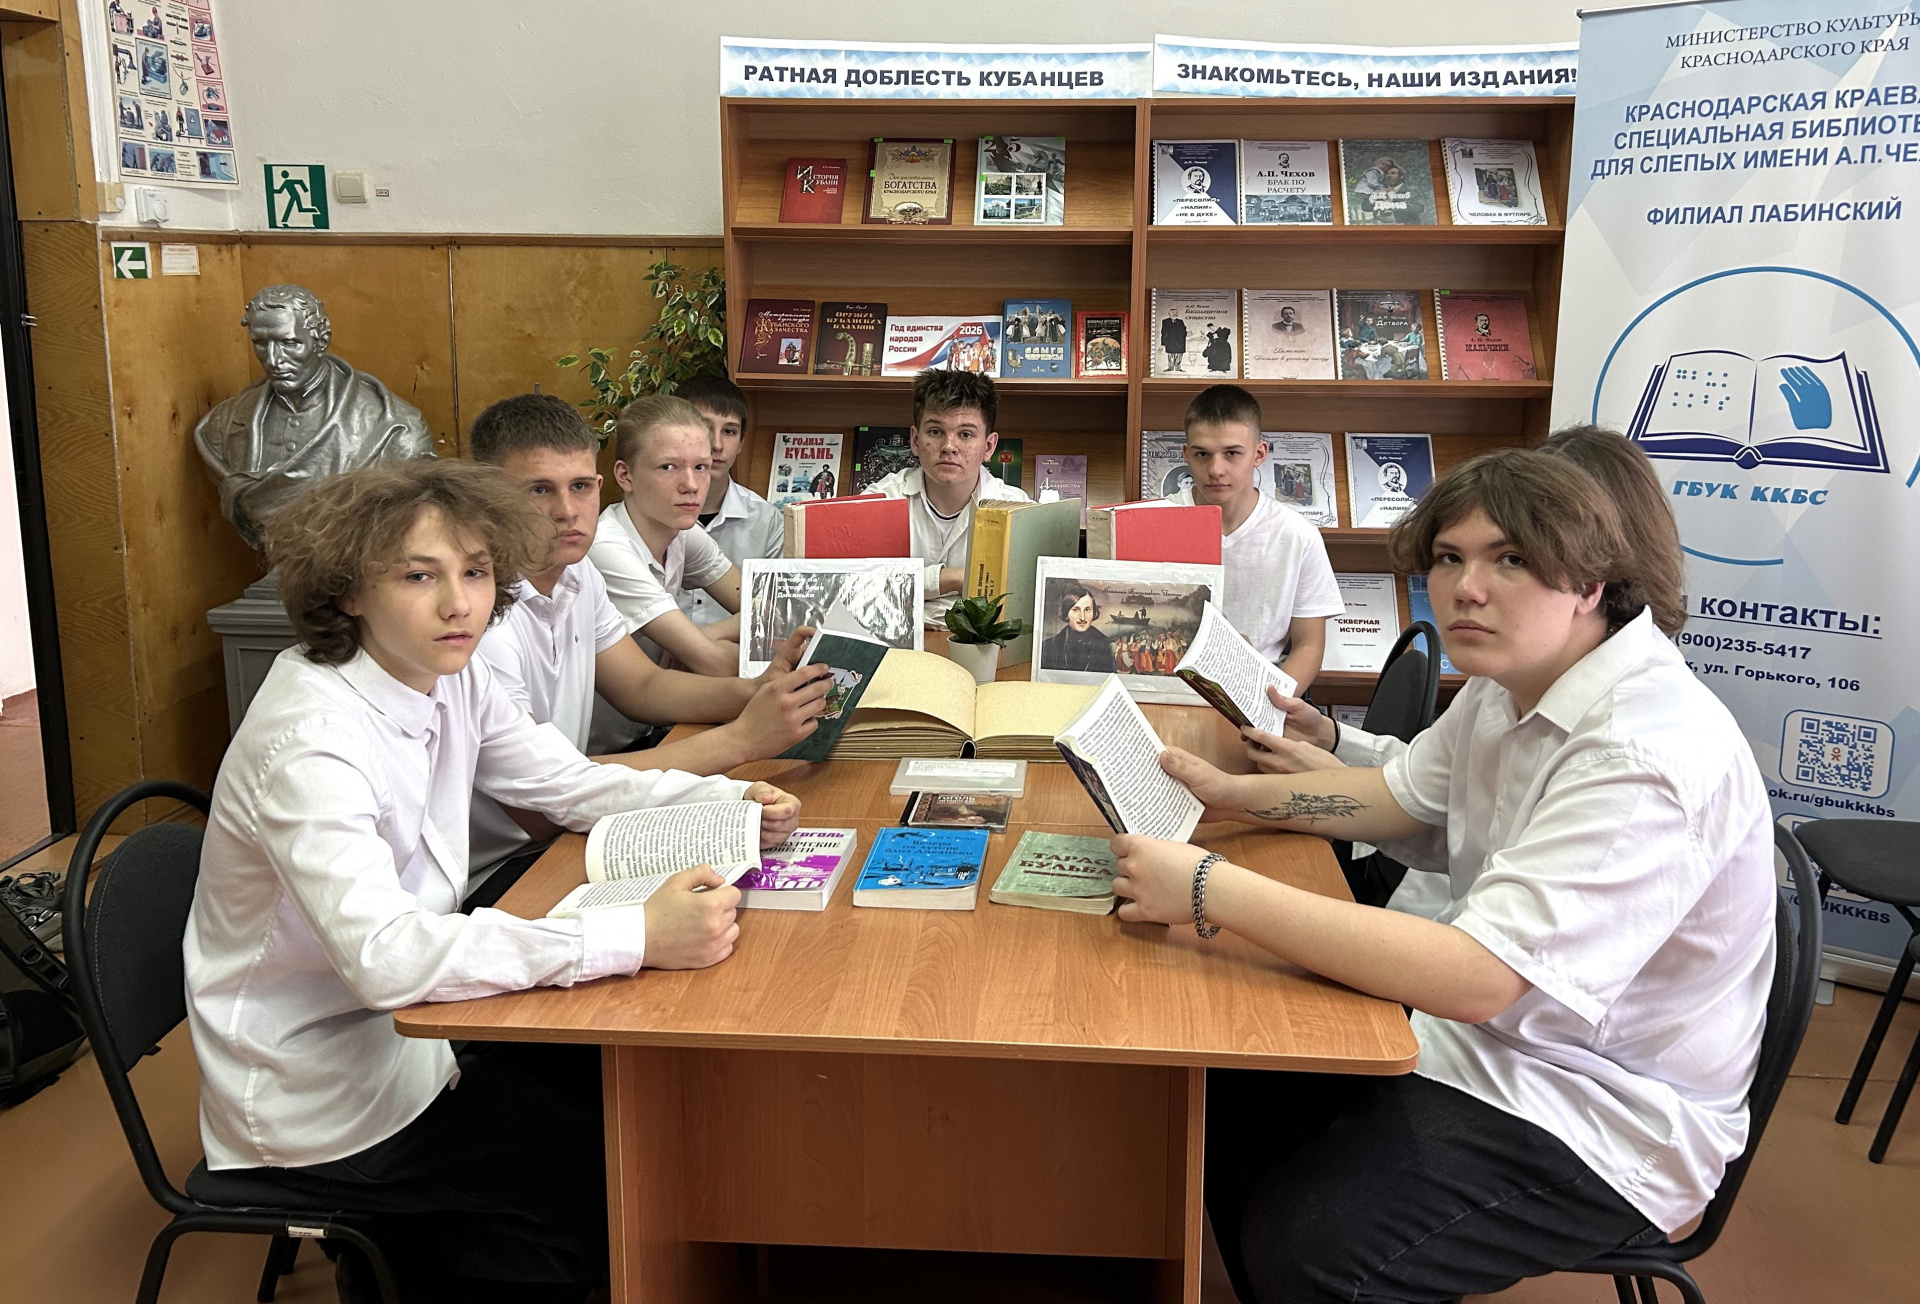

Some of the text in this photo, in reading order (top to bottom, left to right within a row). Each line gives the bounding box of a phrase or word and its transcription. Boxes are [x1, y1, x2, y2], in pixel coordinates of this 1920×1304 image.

[1665, 20, 1821, 49] МИНИСТЕРСТВО
[1680, 36, 1910, 69] КРАСНОДАРСКОГО КРАЯ
[744, 65, 1104, 89] РАТНАЯ ДОБЛЕСТЬ КУБАНЦЕВ
[1176, 62, 1577, 90] ЗНАКОМЬТЕСЬ, НАШИ ИЗДАНИЯ!
[1624, 84, 1920, 123] КРАСНОДАРСКАЯ КРАЕВ
[1613, 121, 1784, 150] СПЕЦИАЛЬНАЯ
[1590, 157, 1634, 181] ДЛЯ
[1639, 151, 1736, 174] СЛЕПЫХ
[1743, 147, 1828, 170] ИМЕНИ
[884, 181, 937, 189] БОГАТСТВА
[1646, 196, 1902, 226] ФИЛИАЛ ЛАБИНСКИЙ
[890, 324, 944, 332] Год единства
[959, 326, 983, 335] 2026
[1465, 344, 1510, 352] МАЛЬЧИКИ
[784, 447, 834, 461] КУБАНЬ
[792, 438, 825, 446] РОДНАЯ
[1672, 480, 1829, 506] ГБУК ККБС
[1334, 618, 1380, 626] "СКВЕРНАЯ
[1700, 596, 1882, 635] контакты:
[1704, 662, 1729, 678] ул.
[1734, 665, 1821, 689] Горького,
[1827, 677, 1860, 691] 106
[1768, 789, 1896, 818] ok.ru/gbukkkbs
[1018, 860, 1114, 876] БУЛЬБА
[1032, 852, 1111, 866] ТАРАС
